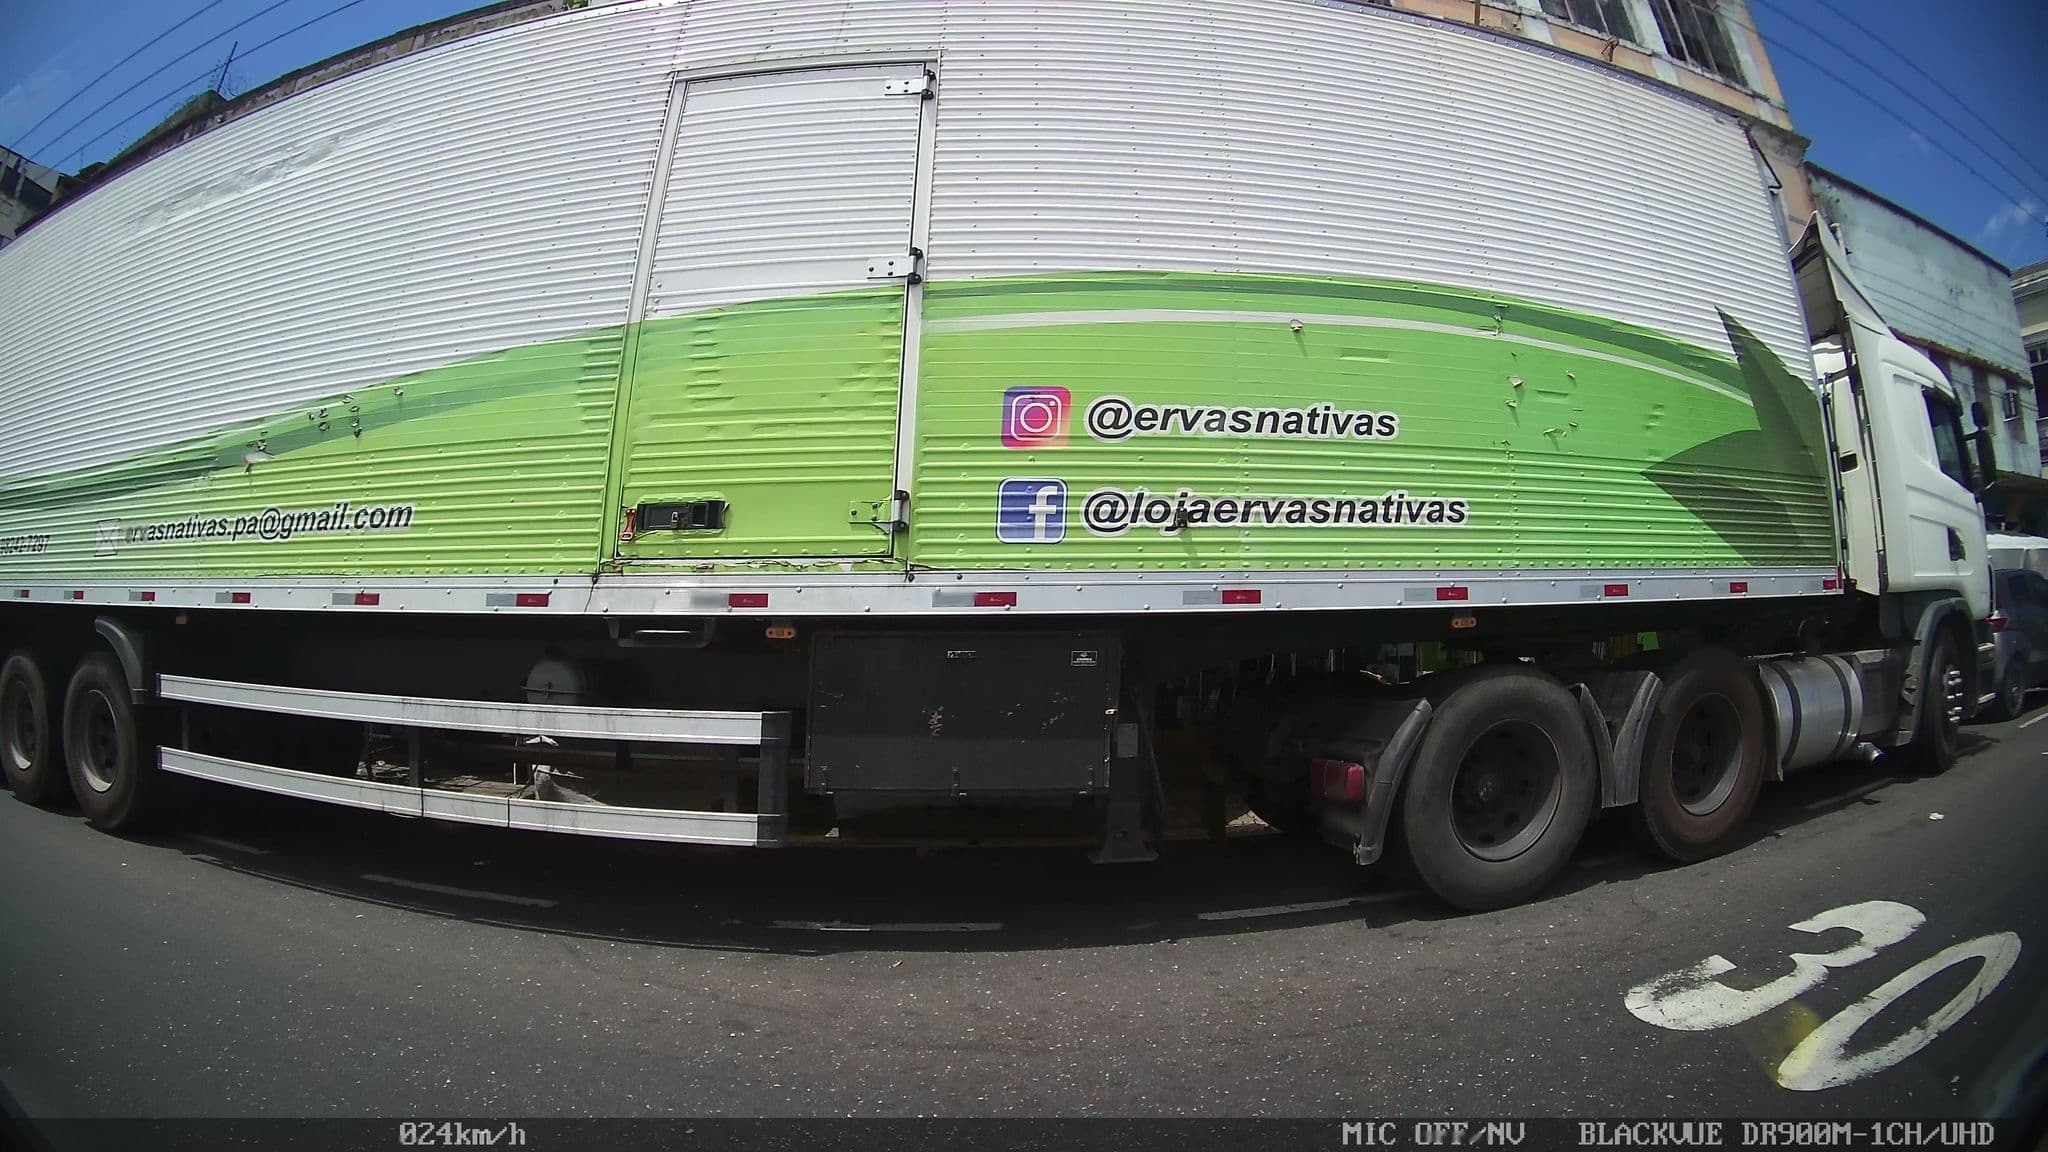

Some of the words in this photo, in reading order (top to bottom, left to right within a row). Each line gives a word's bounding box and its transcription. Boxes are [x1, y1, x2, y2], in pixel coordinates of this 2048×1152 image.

[1086, 398, 1398, 441] @ervasnativas
[1083, 490, 1468, 535] @lojaervasnativas
[1624, 900, 2022, 1092] 30
